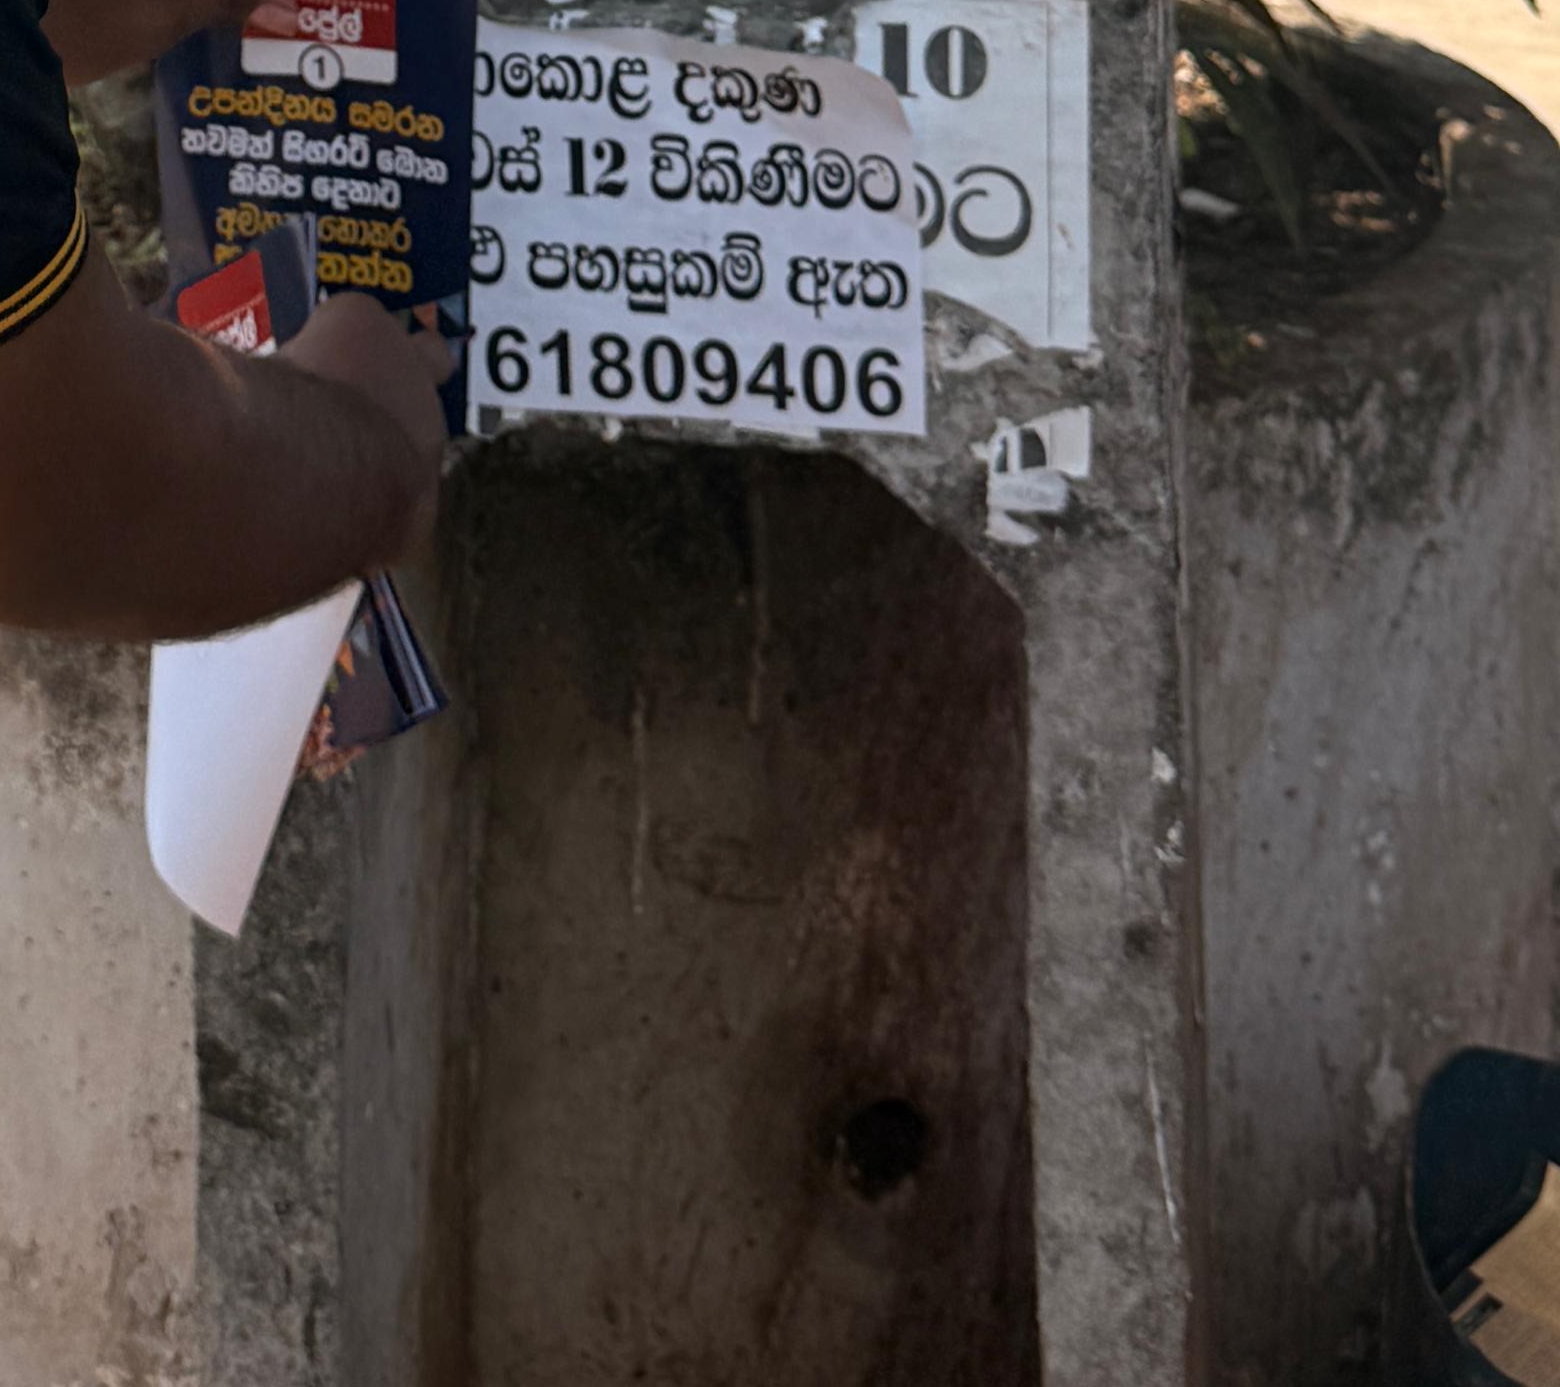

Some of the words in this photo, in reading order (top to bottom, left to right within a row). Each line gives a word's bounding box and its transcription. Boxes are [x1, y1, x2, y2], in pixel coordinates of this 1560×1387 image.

[313, 55, 326, 81] 1
[474, 50, 652, 118] ාකොළ
[674, 59, 822, 124] දකුණ
[879, 22, 989, 100] 10
[564, 135, 630, 199] 12
[649, 132, 903, 212] විකිණීමට
[527, 232, 765, 314] පහසුකම්
[786, 254, 911, 318] ඇත
[485, 326, 904, 417] 61809406
